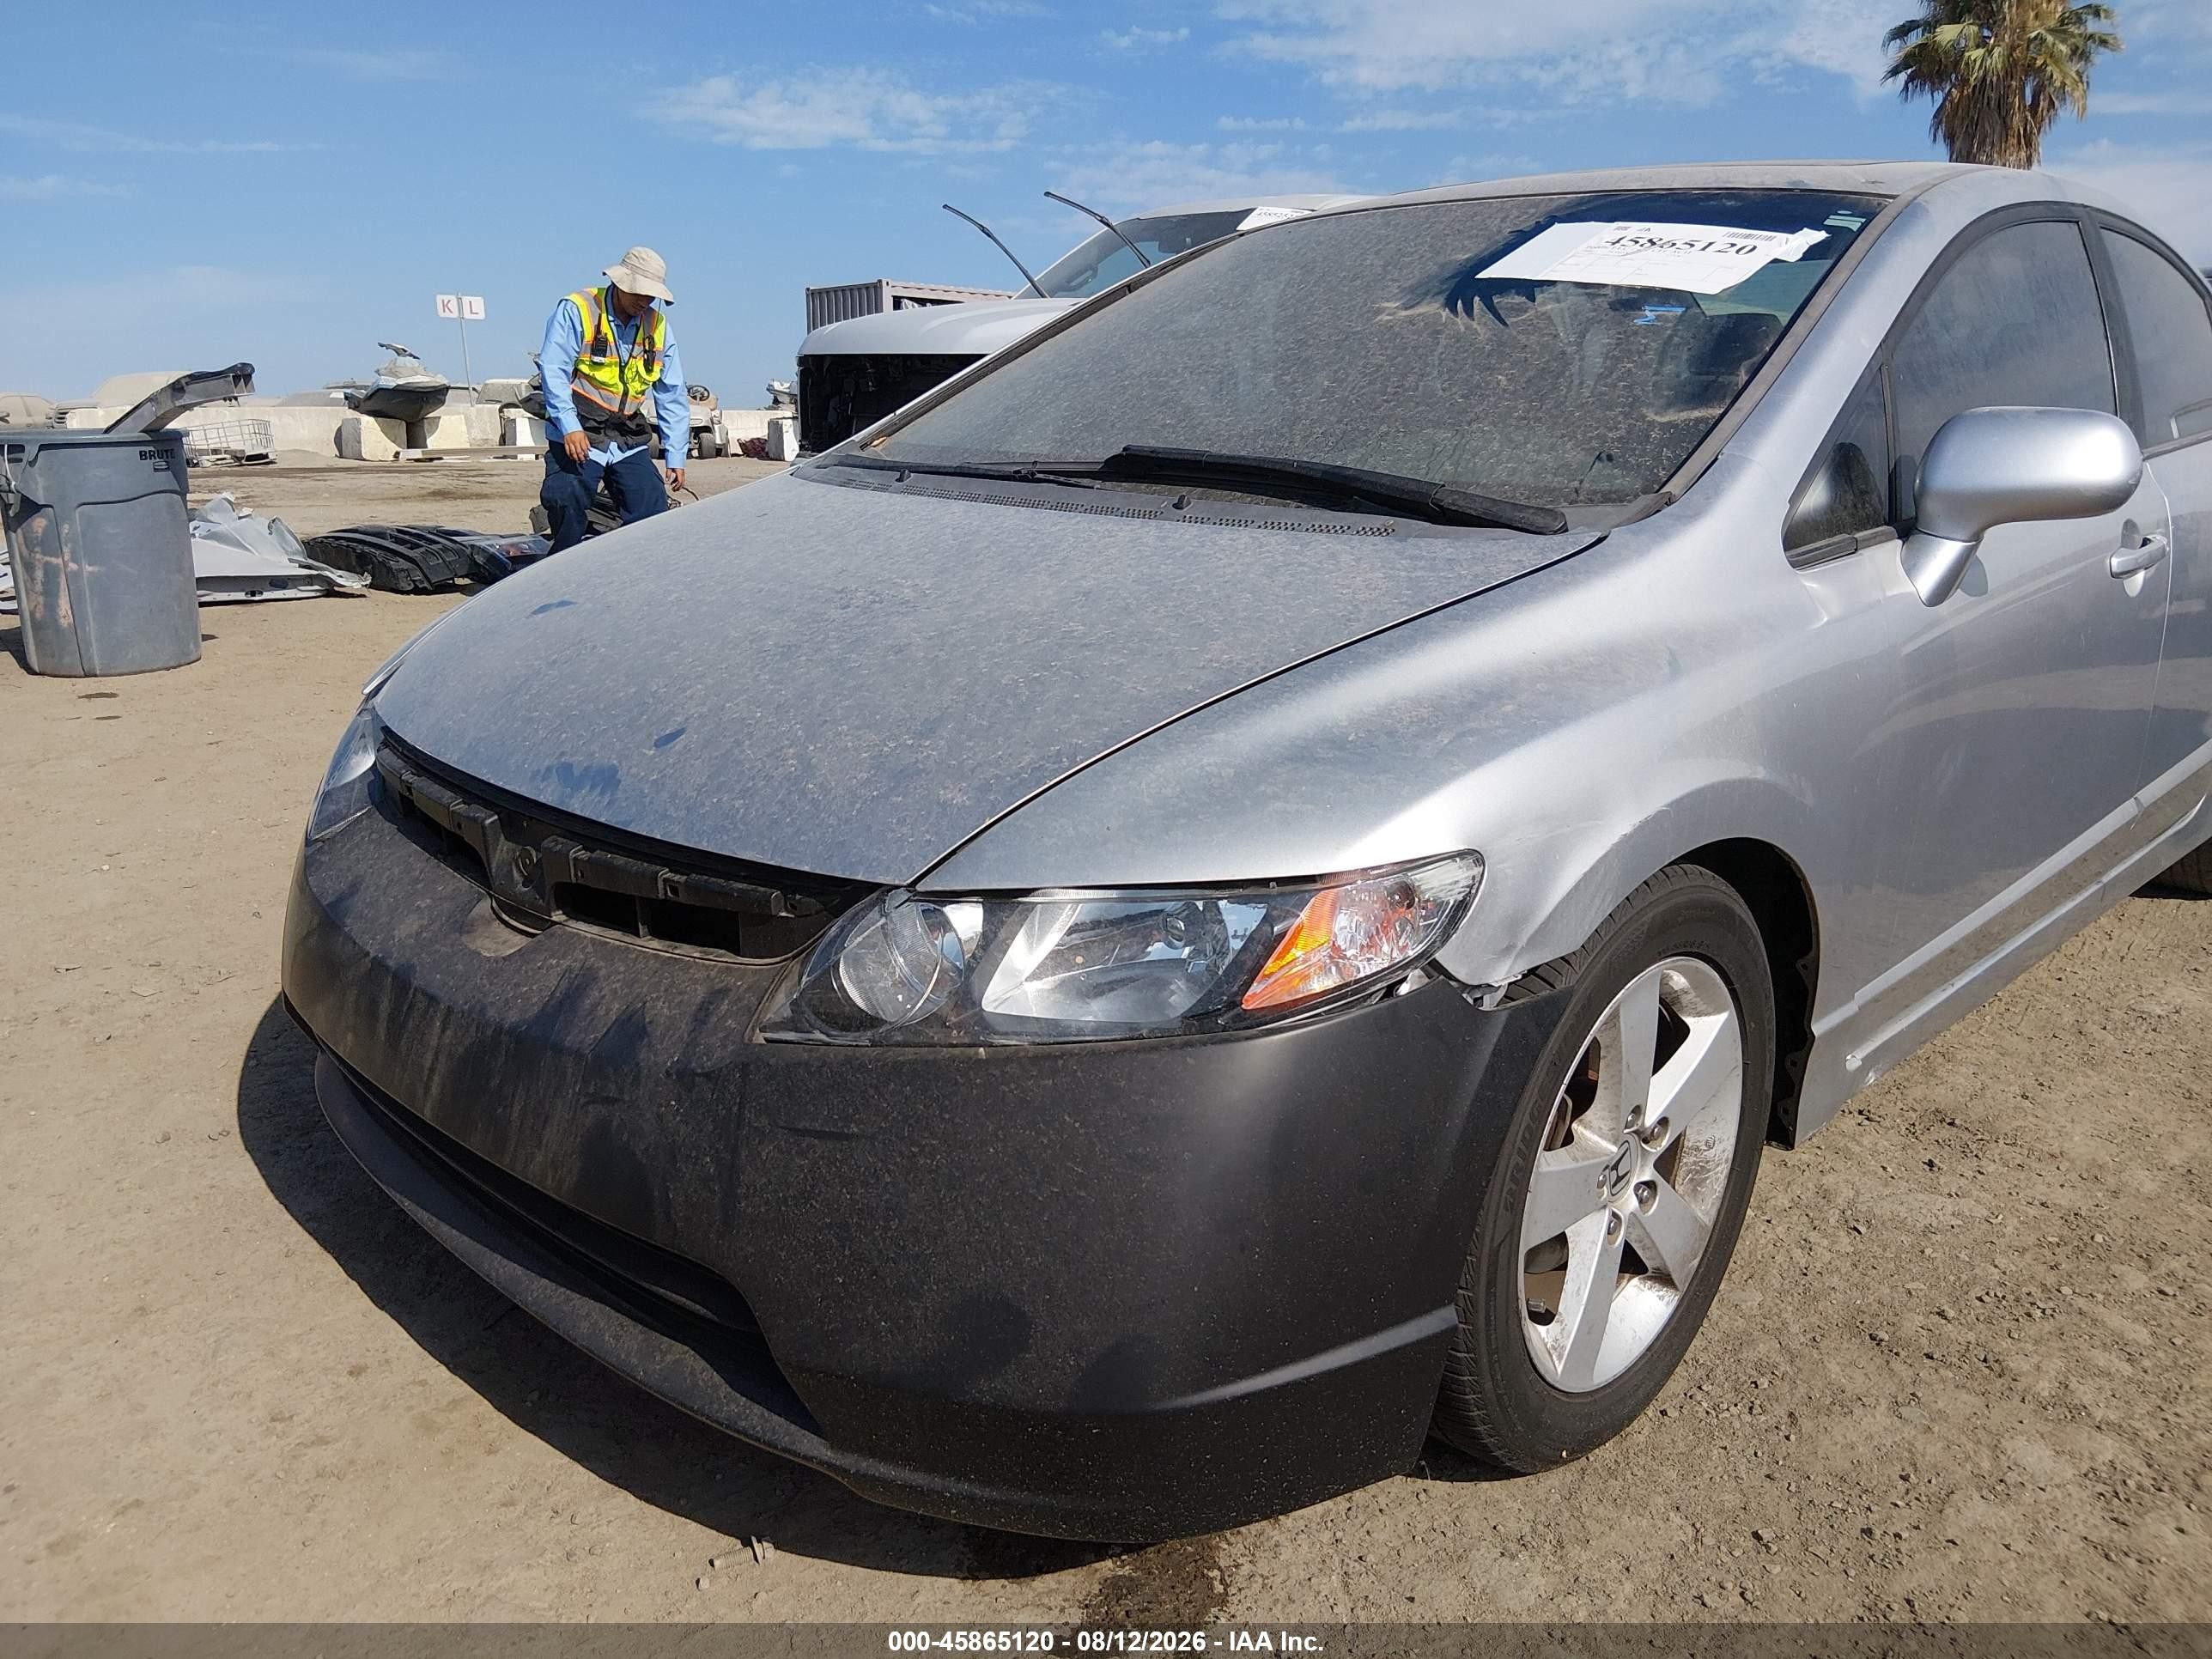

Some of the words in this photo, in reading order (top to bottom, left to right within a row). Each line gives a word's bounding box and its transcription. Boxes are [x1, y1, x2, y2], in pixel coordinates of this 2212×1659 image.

[1604, 235, 1758, 255] 45865120
[441, 299, 453, 313] K
[469, 301, 479, 314] L
[139, 448, 175, 460] BRUTE
